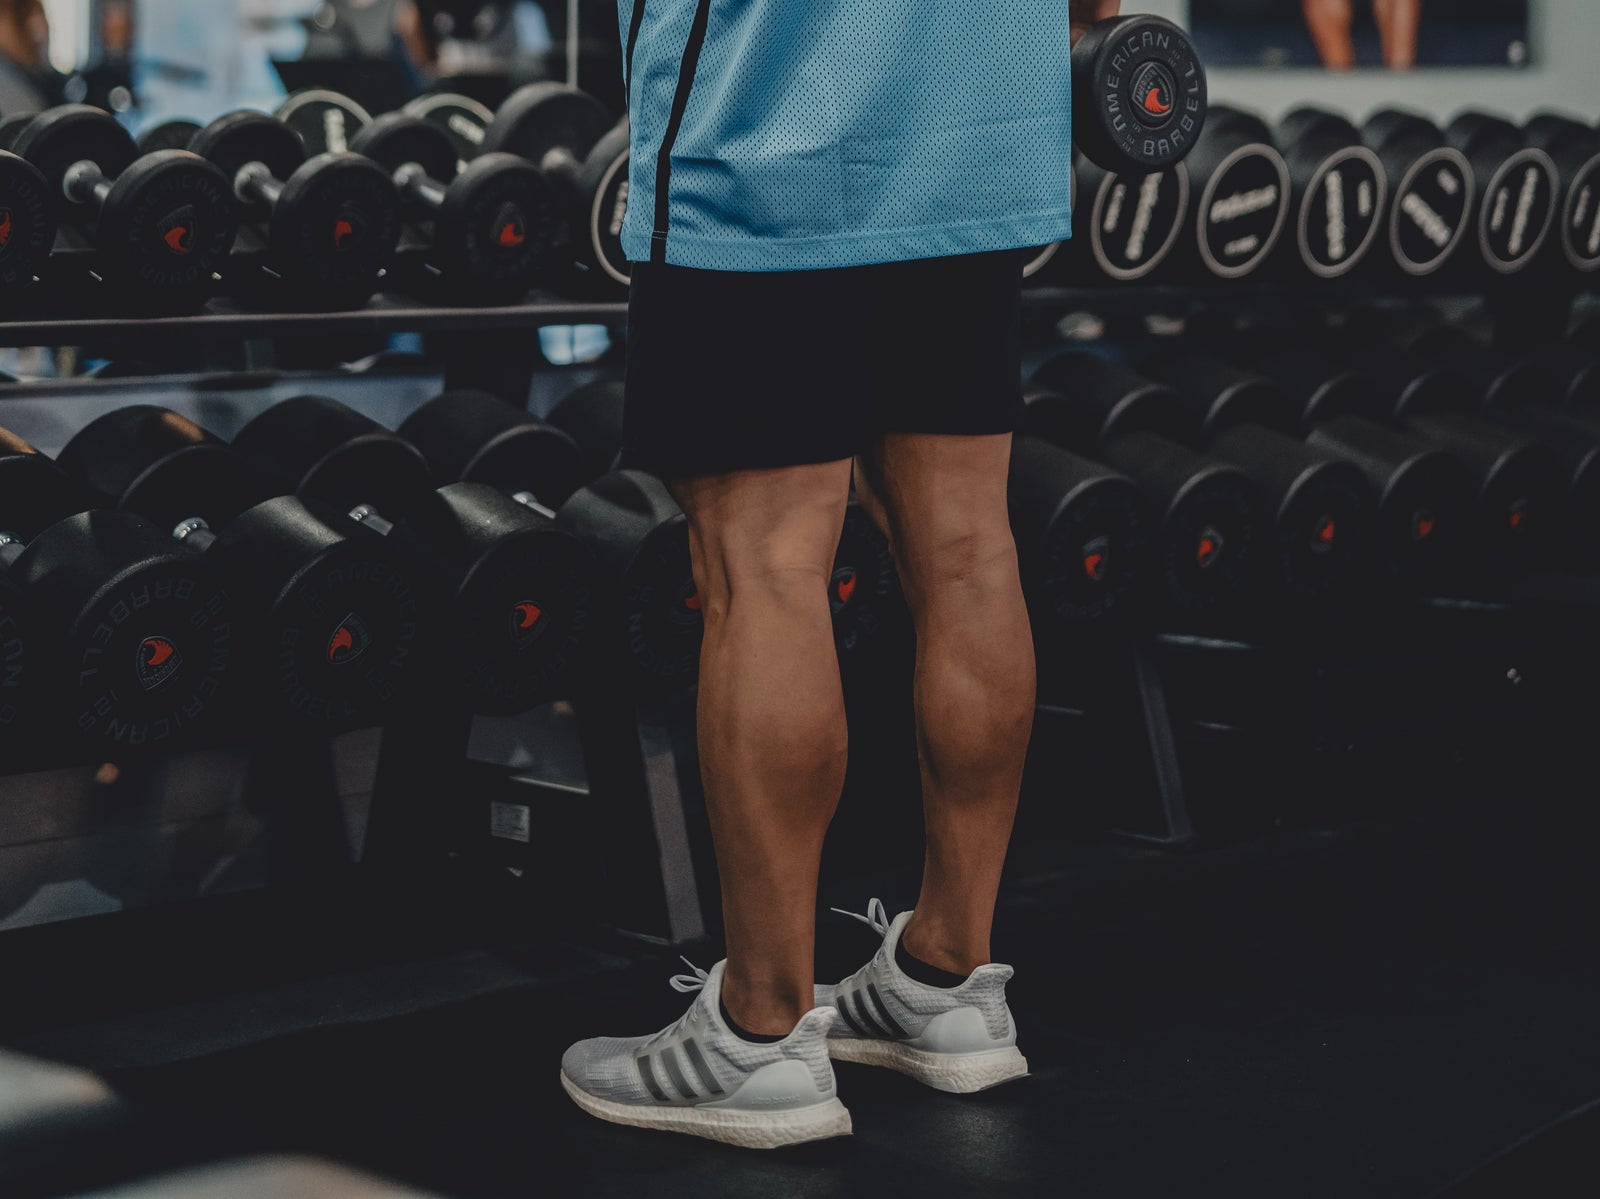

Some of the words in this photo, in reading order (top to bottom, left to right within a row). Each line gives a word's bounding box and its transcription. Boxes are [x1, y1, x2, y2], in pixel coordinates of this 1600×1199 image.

[1106, 30, 1170, 132] AMERICAN
[1143, 60, 1199, 156] BARBELL
[79, 578, 195, 689] BARBELL
[104, 622, 232, 744] AMERICAN
